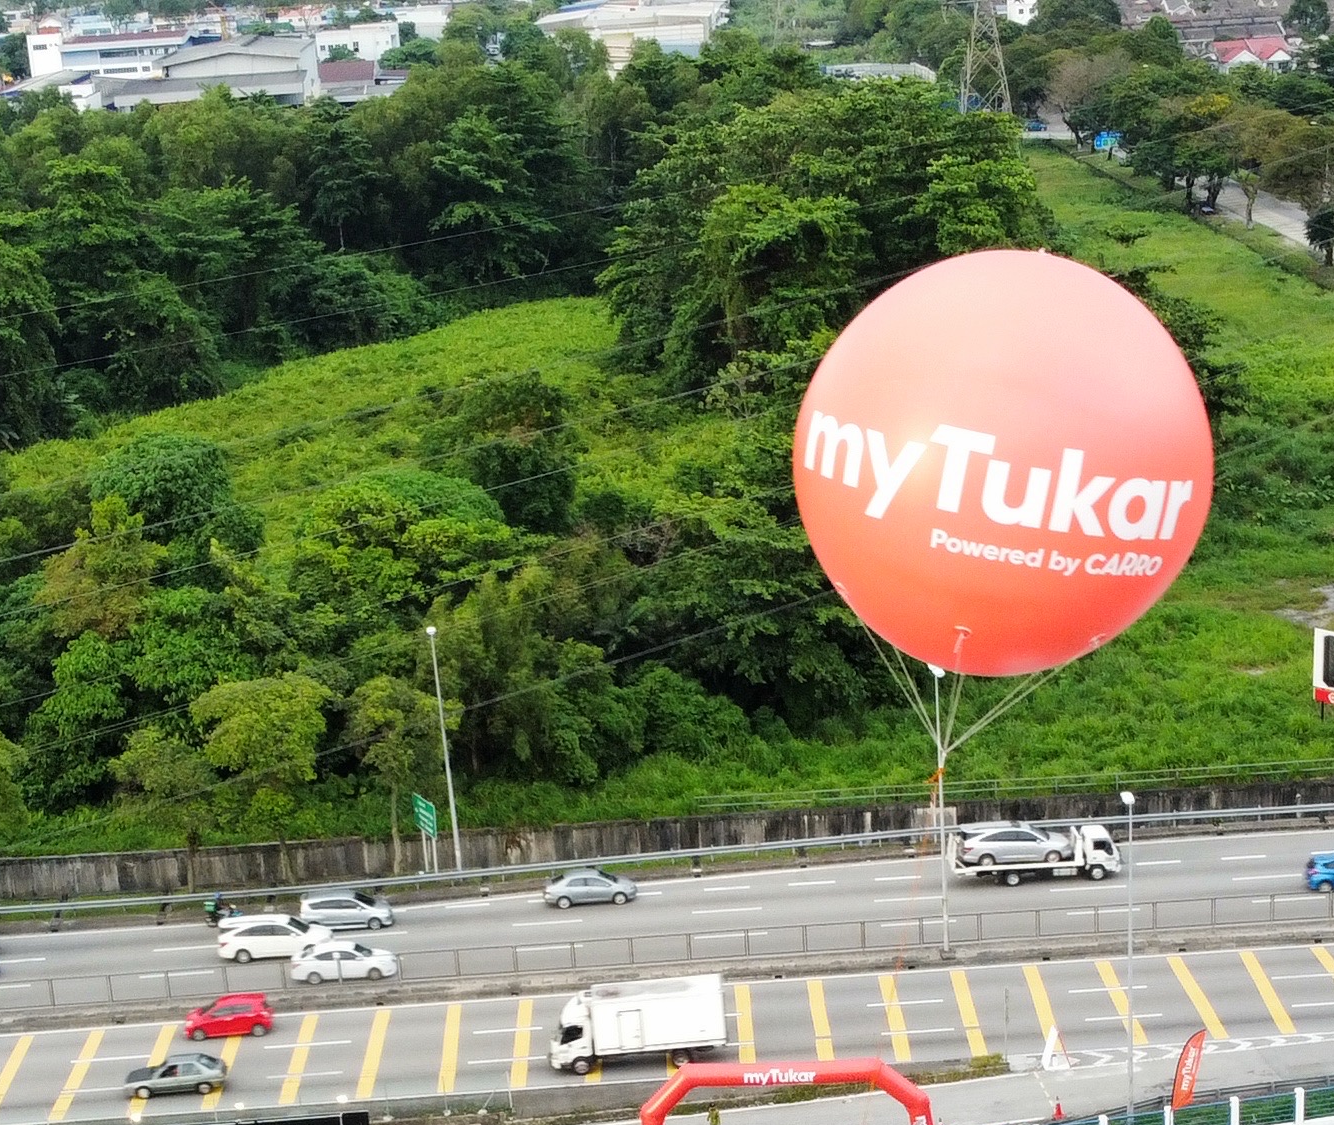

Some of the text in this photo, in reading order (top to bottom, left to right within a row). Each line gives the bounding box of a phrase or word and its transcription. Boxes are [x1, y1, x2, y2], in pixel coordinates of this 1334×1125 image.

[803, 409, 1194, 542] myTukar
[929, 527, 1164, 577] Powered by CARRO
[743, 1067, 816, 1086] myTukar
[1180, 1045, 1197, 1092] myTukar
